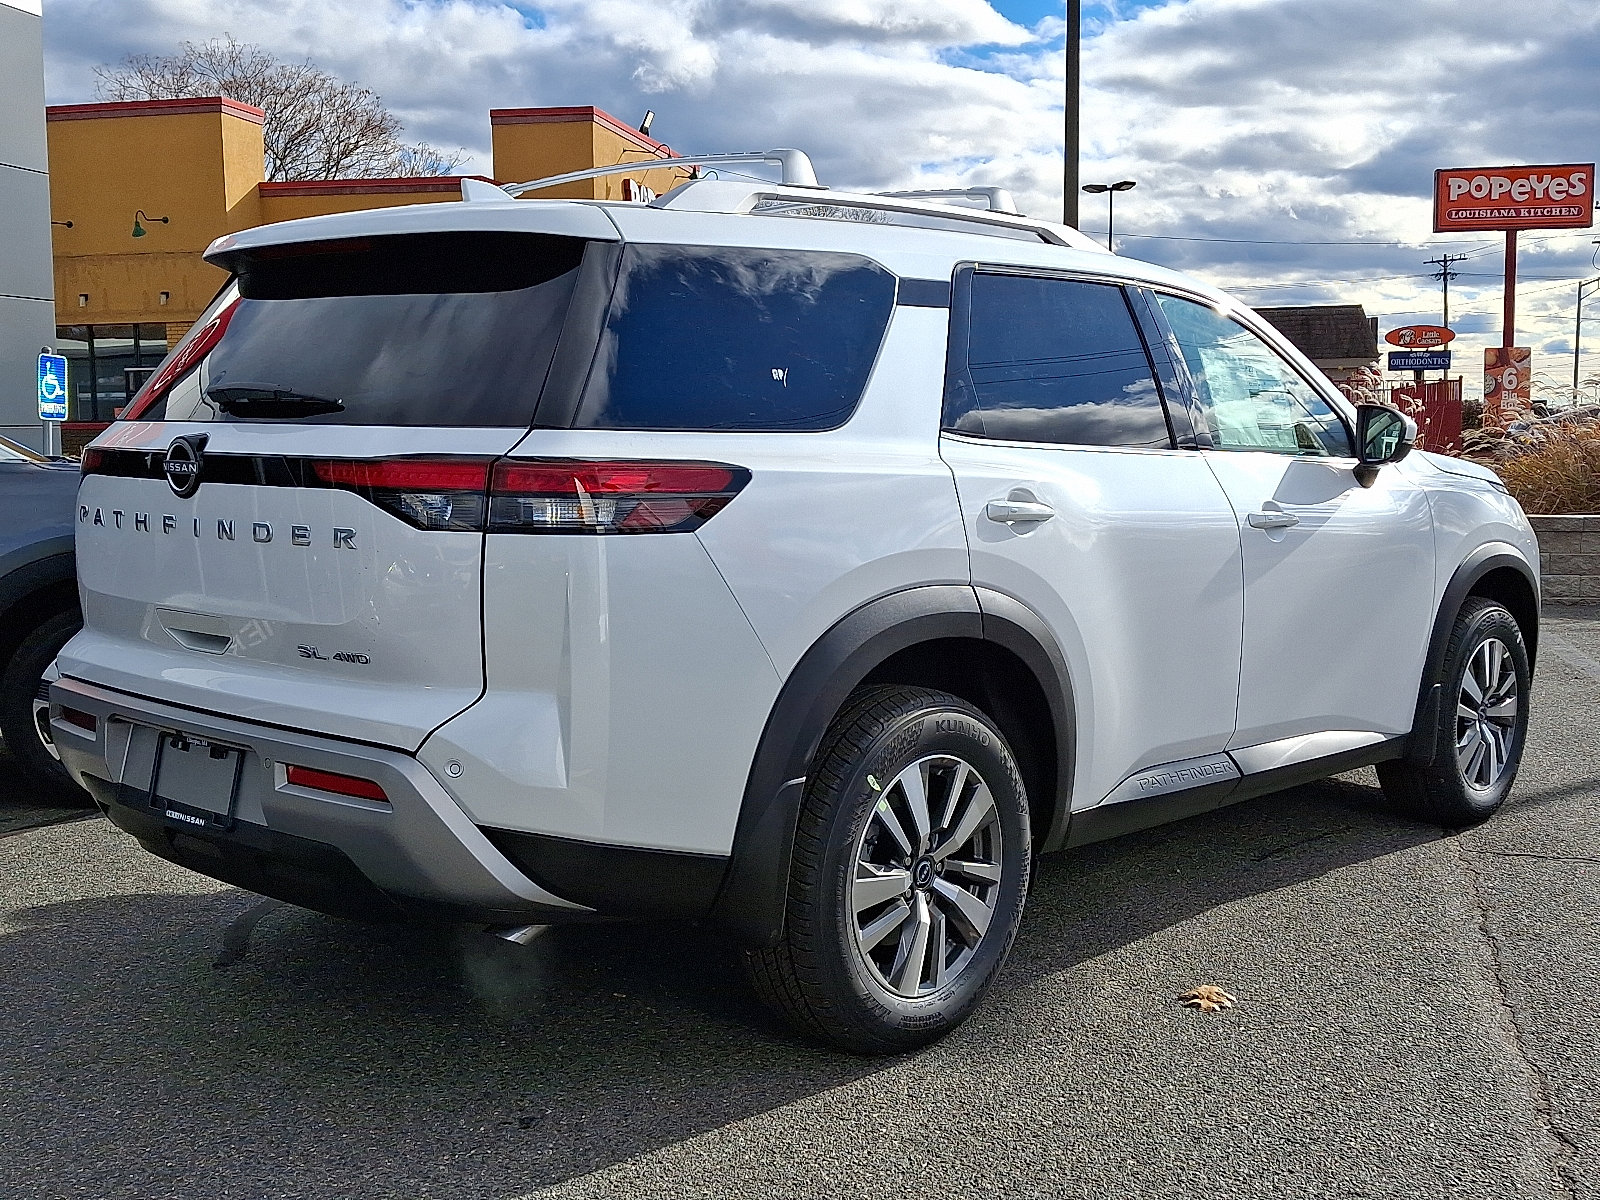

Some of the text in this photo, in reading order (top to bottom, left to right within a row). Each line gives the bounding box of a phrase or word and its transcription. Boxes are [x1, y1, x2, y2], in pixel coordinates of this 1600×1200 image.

[1450, 206, 1580, 219] LOUISIANA KITCHEN
[1422, 330, 1440, 339] Little
[1390, 357, 1450, 366] ORTHODONTICS
[162, 460, 199, 474] NISSAN
[79, 504, 358, 551] PATHFINDER
[297, 643, 329, 661] SL
[934, 719, 991, 747] KUMHO
[1136, 760, 1234, 792] PATHFINDER
